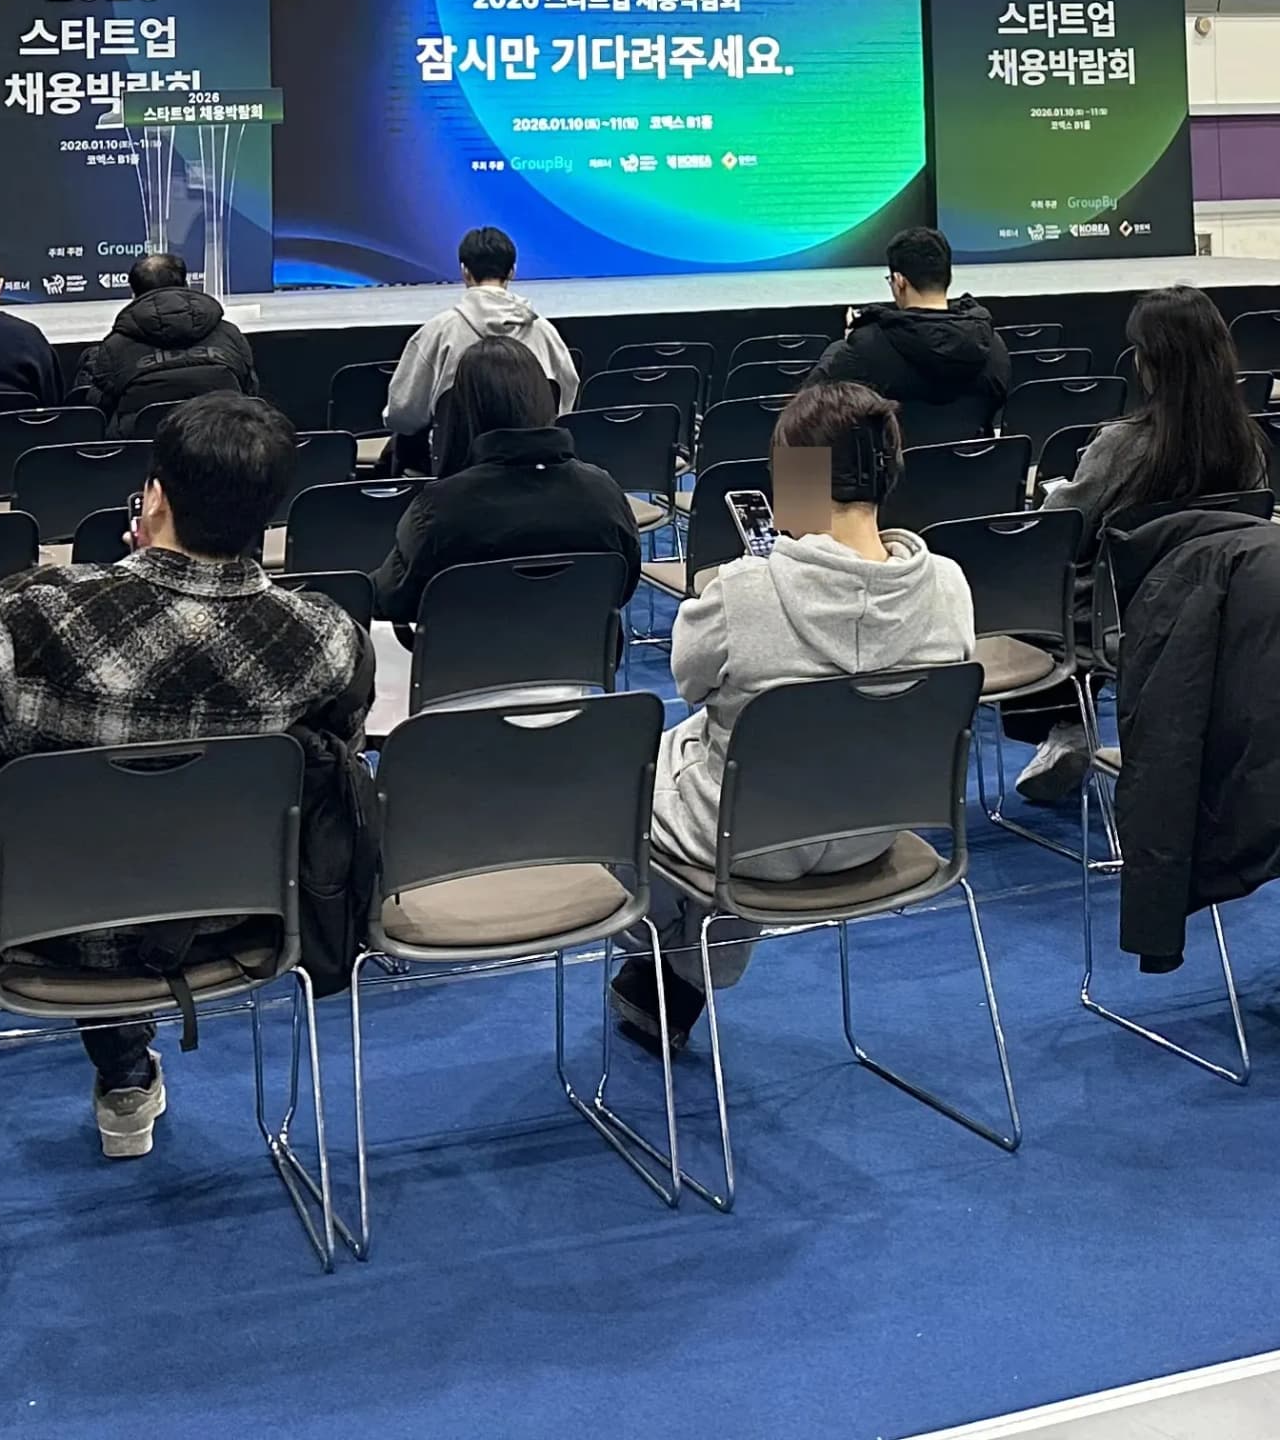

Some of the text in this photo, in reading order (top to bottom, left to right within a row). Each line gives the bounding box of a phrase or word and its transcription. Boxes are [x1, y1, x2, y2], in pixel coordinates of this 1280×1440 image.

[997, 1, 1116, 38] 스타트업
[18, 16, 176, 60] 스타트업
[415, 34, 795, 82] 잠시만 기다려주세요.
[988, 48, 1136, 86] 채용박람회
[188, 92, 220, 104] 2026
[143, 104, 263, 122] 스타트업 채용박람회
[86, 154, 116, 166] 코엑스
[510, 155, 574, 173] GroupBy
[1067, 195, 1118, 211] GroupBy
